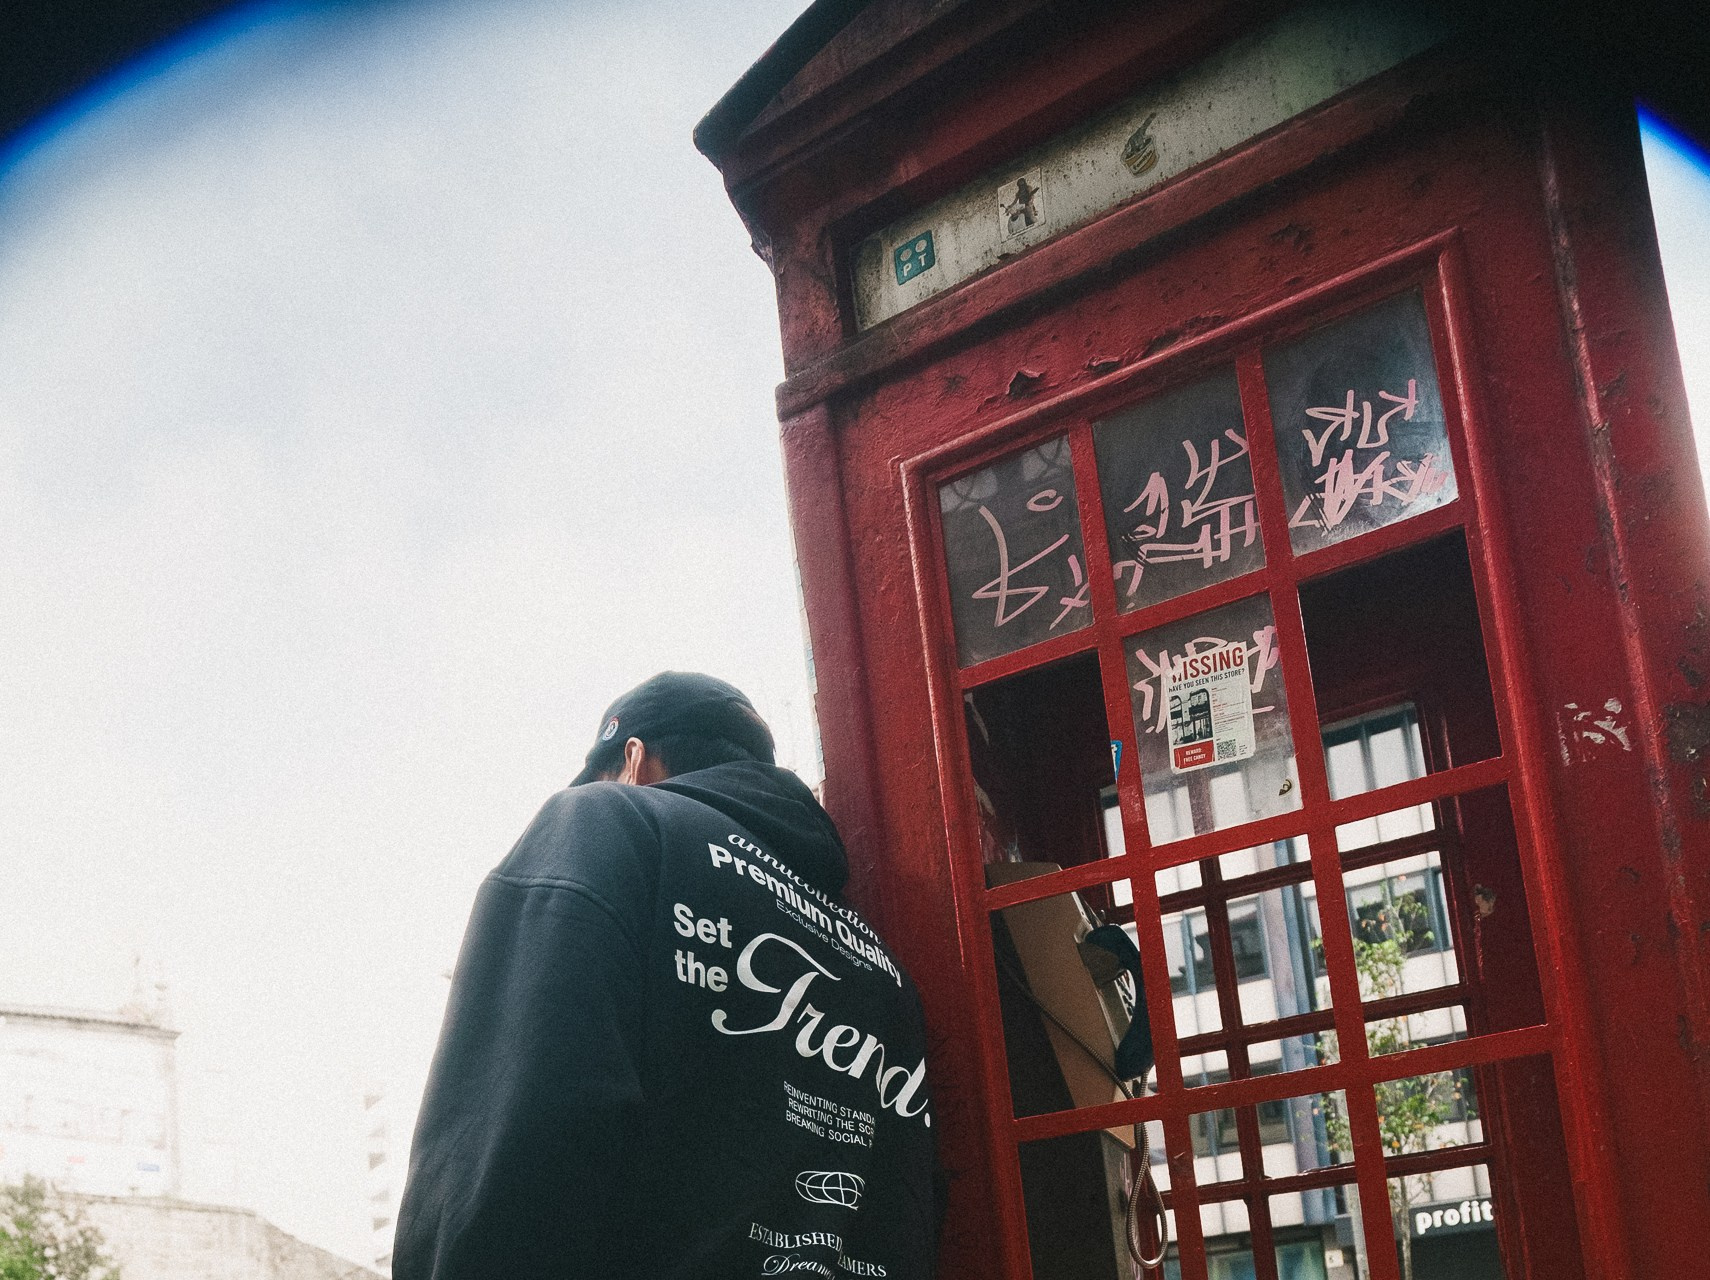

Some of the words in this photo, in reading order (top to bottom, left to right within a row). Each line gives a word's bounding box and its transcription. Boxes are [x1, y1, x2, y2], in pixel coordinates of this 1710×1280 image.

[1171, 646, 1244, 684] ISSING
[1183, 681, 1195, 690] YOU
[1195, 677, 1210, 687] SEEN
[1210, 673, 1223, 683] THIS
[1224, 668, 1245, 679] STORE?
[673, 902, 733, 949] Set
[708, 842, 833, 932] Premium
[835, 920, 902, 988] Quality
[775, 898, 829, 944] Exclusive
[830, 937, 873, 972] Designs
[674, 949, 729, 992] the
[711, 932, 931, 1128] Trend.
[783, 1080, 838, 1114] REINVENTING
[788, 1097, 833, 1126] REWRITING
[835, 1117, 856, 1131] THE
[785, 1109, 825, 1138] BREAKING
[828, 1129, 868, 1147] SOCIAL
[1415, 1200, 1494, 1235] profit
[748, 1222, 843, 1252] ESTABLISHED
